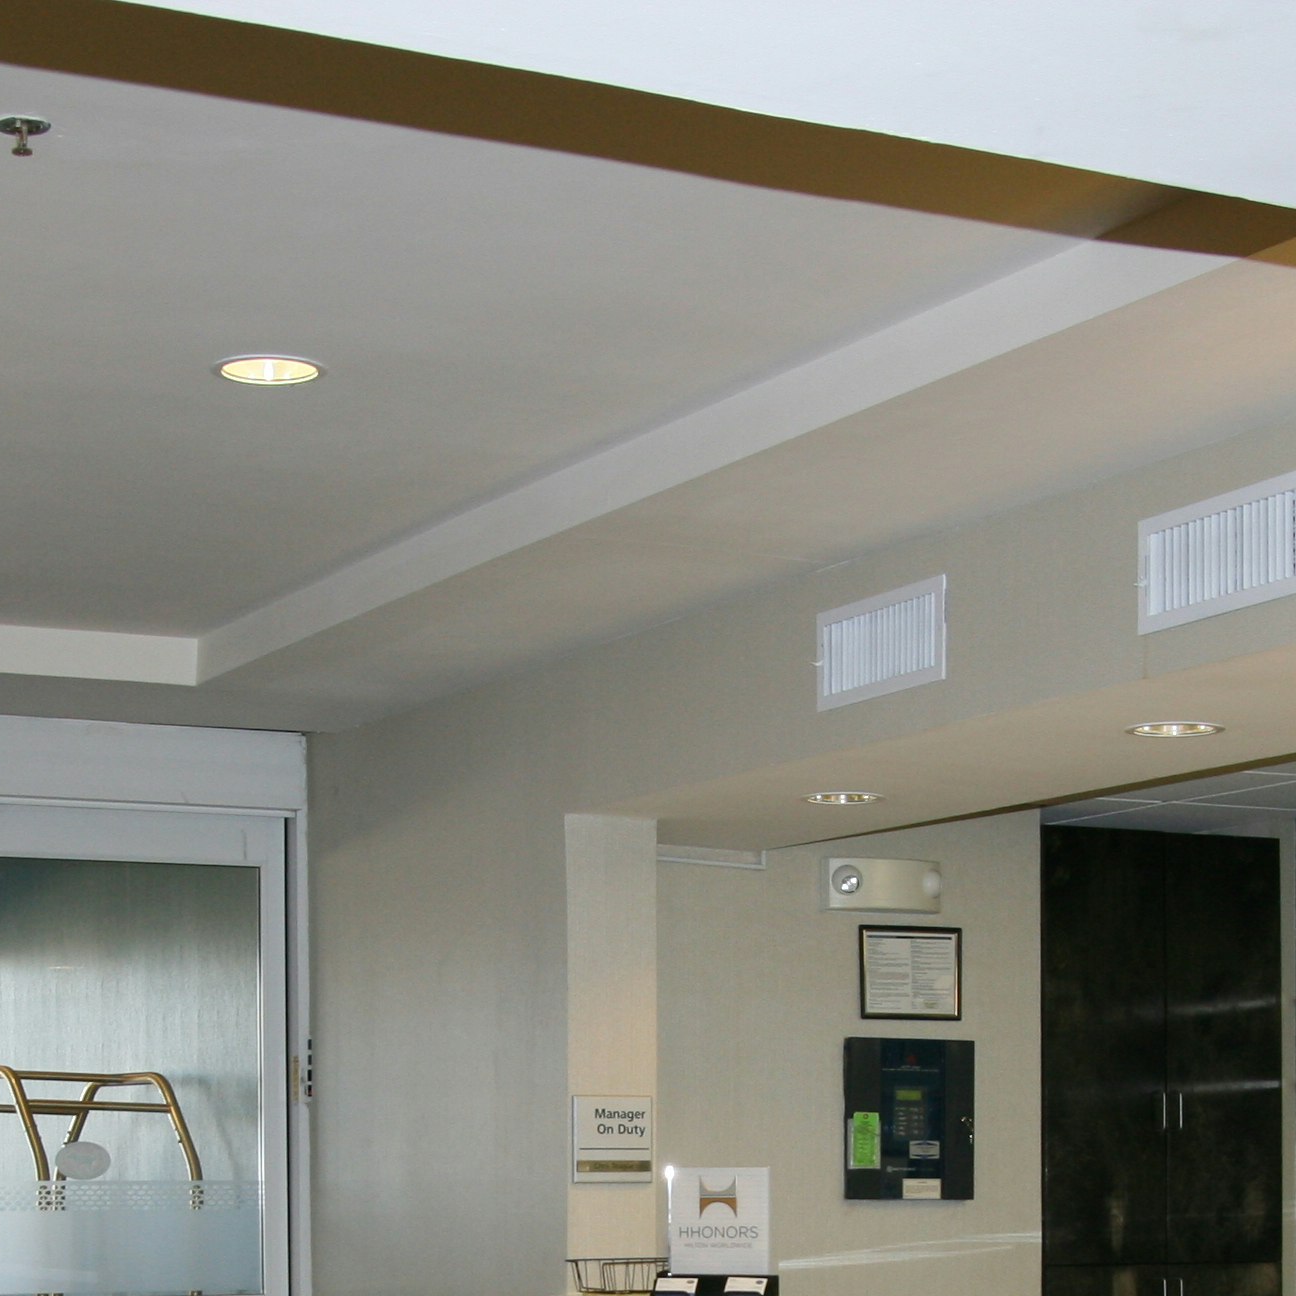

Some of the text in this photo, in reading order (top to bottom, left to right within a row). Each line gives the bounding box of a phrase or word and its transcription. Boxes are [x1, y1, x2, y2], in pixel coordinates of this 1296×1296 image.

[594, 1108, 646, 1122] Manager
[597, 1123, 646, 1137] On Duty
[679, 1225, 759, 1239] HHONORS
